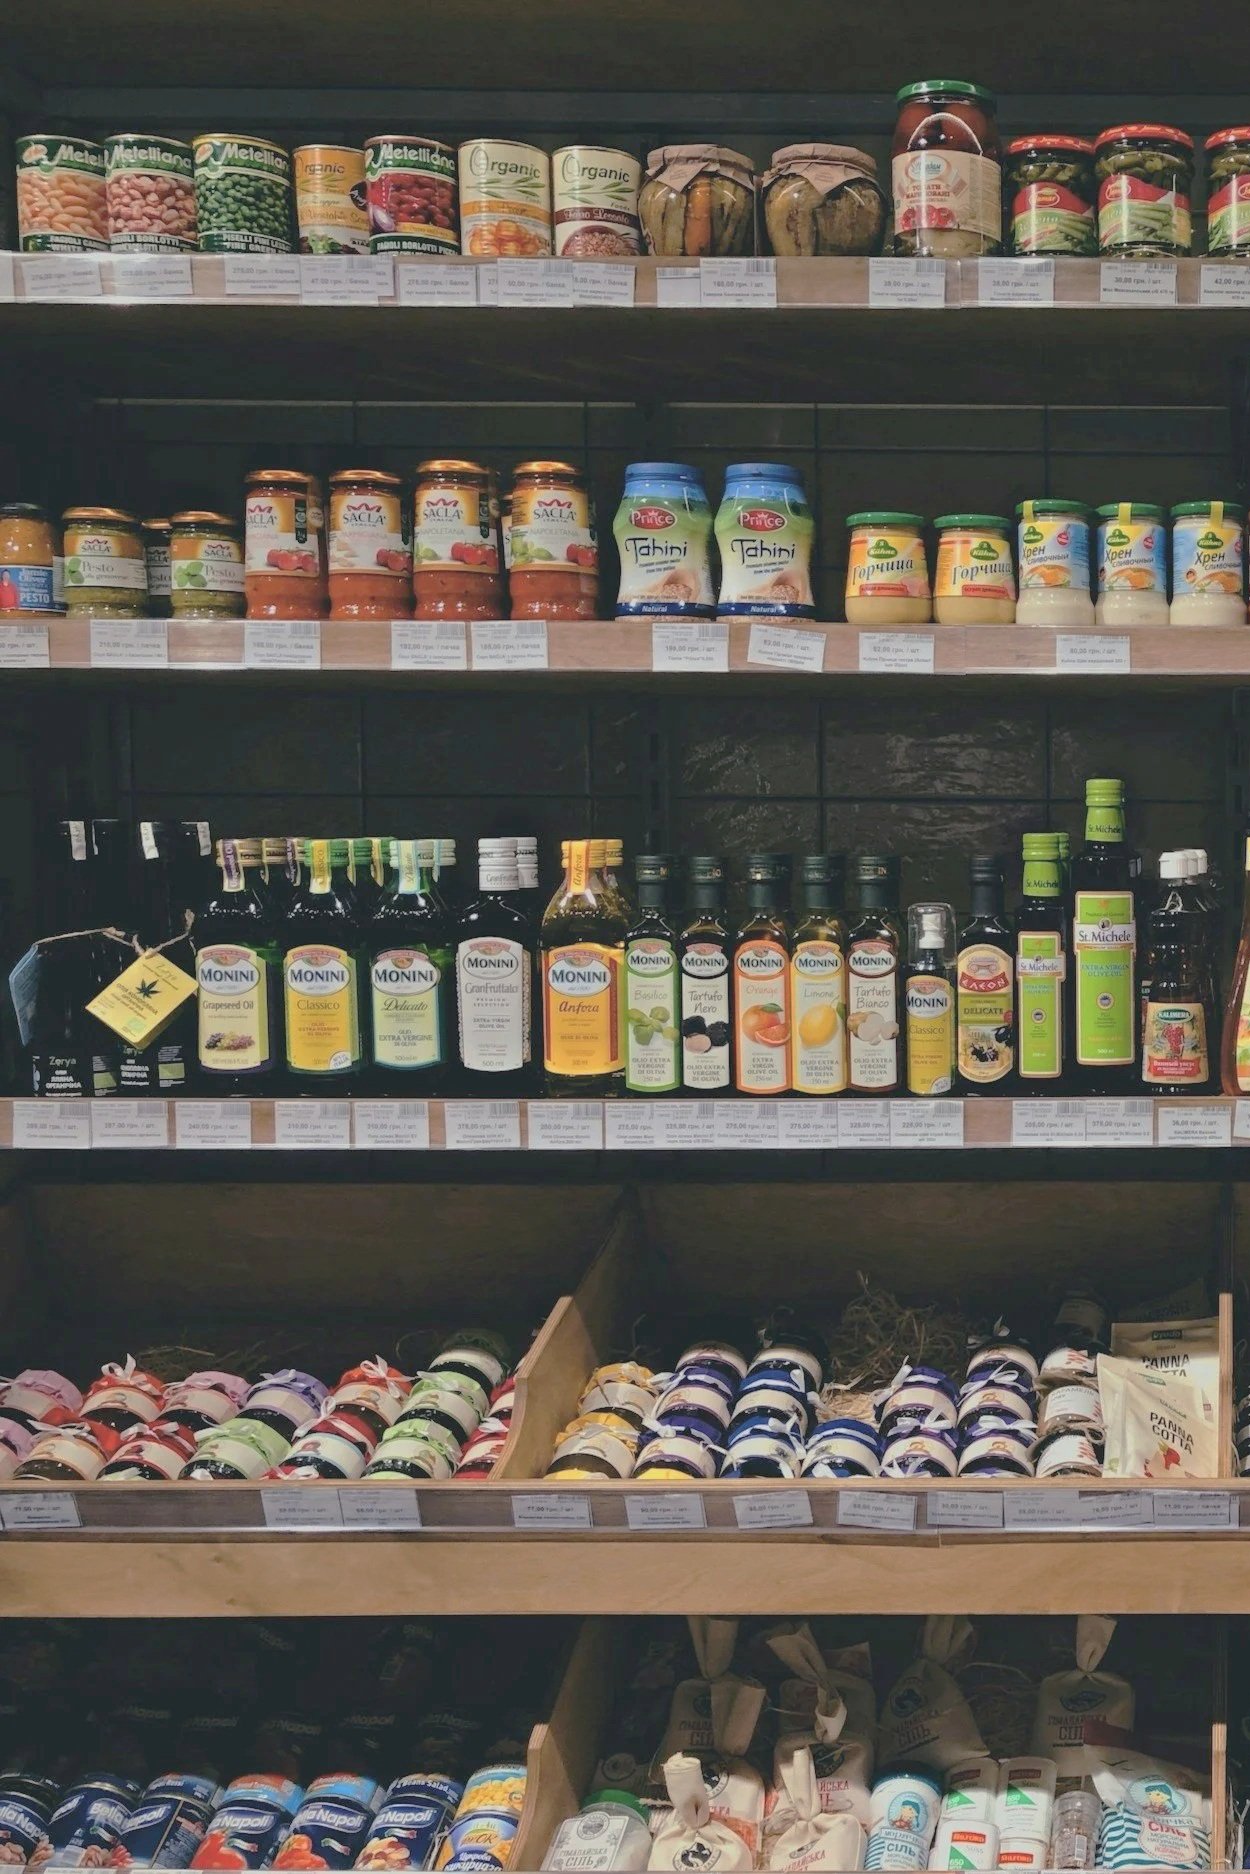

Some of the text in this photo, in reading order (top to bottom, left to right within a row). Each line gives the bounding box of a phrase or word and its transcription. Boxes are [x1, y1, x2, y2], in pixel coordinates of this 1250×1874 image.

[631, 510, 676, 529] Prince
[740, 511, 783, 528] Prince
[625, 537, 688, 565] Tahini
[731, 537, 795, 565] Tahini
[1023, 546, 1045, 561] Хрен
[1106, 549, 1132, 563] Хрен
[1195, 552, 1225, 565] Хрен
[81, 561, 113, 572] Pesto
[205, 566, 236, 577] Pesto
[853, 558, 914, 585] Горчица
[953, 560, 1012, 585] Горчица
[19, 593, 49, 603] PESTO
[467, 959, 514, 969] MONINI
[630, 955, 671, 966] MONINI
[685, 957, 725, 968] MONINI
[740, 957, 782, 968] MONINI
[798, 958, 839, 968] MONINI
[201, 970, 255, 983] MONINI
[290, 970, 345, 983] MONINI
[374, 969, 435, 983] MONINI
[551, 970, 607, 984] MONINI
[465, 982, 519, 994] GranFruttato
[746, 985, 779, 998] Orange
[803, 988, 835, 999] Limone
[854, 985, 891, 997] Tartufo
[634, 990, 668, 1000] Basilico
[688, 991, 723, 1003] Tartufo
[202, 1001, 254, 1011] Grapeseed Oil
[297, 1001, 340, 1011] Classico
[381, 998, 428, 1012] Delicato
[559, 1001, 600, 1013] Anfora
[693, 1002, 717, 1014] Nero
[856, 997, 889, 1008] Bianco
[964, 1007, 1004, 1015] DELICATE
[910, 1026, 945, 1035] Classico
[1150, 1412, 1194, 1447] PANNA
[1152, 1424, 1193, 1455] COTTA
[887, 1843, 916, 1857] СІЛЬ
